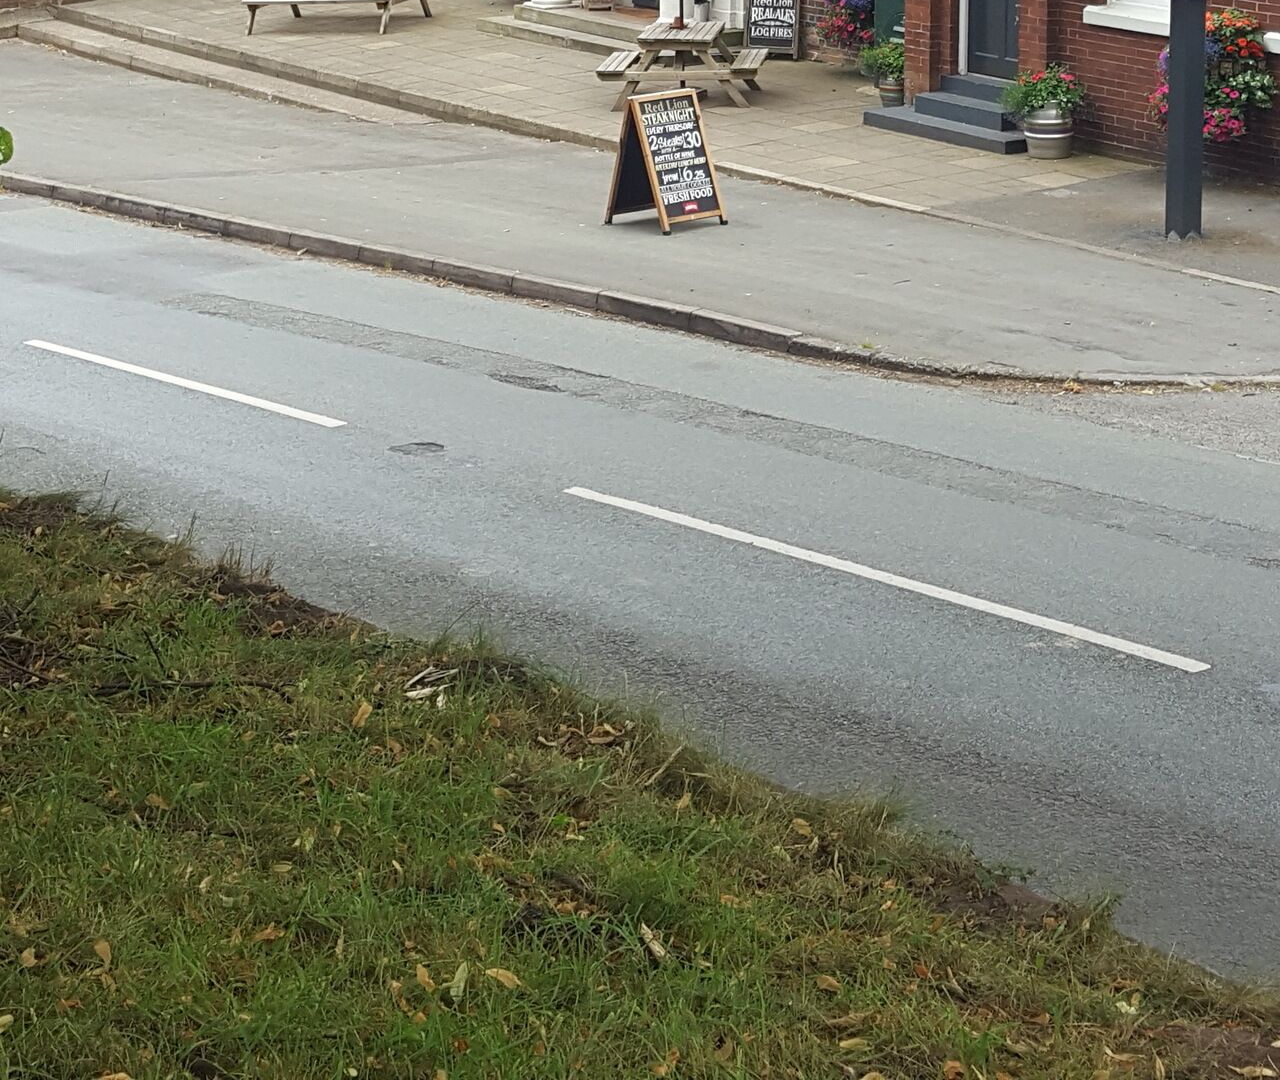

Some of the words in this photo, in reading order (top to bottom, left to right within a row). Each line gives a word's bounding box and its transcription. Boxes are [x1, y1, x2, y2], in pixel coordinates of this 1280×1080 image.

[751, 7, 775, 22] REAL
[774, 8, 795, 24] ALES
[751, 26, 769, 37] LOG
[770, 27, 793, 38] FIRES
[644, 101, 664, 115] Red
[666, 99, 689, 110] Lion
[642, 111, 668, 126] STEAK
[667, 107, 696, 123] NIGHT
[649, 135, 659, 151] 2
[663, 191, 690, 206] FRESH
[690, 187, 713, 201] FOOD
